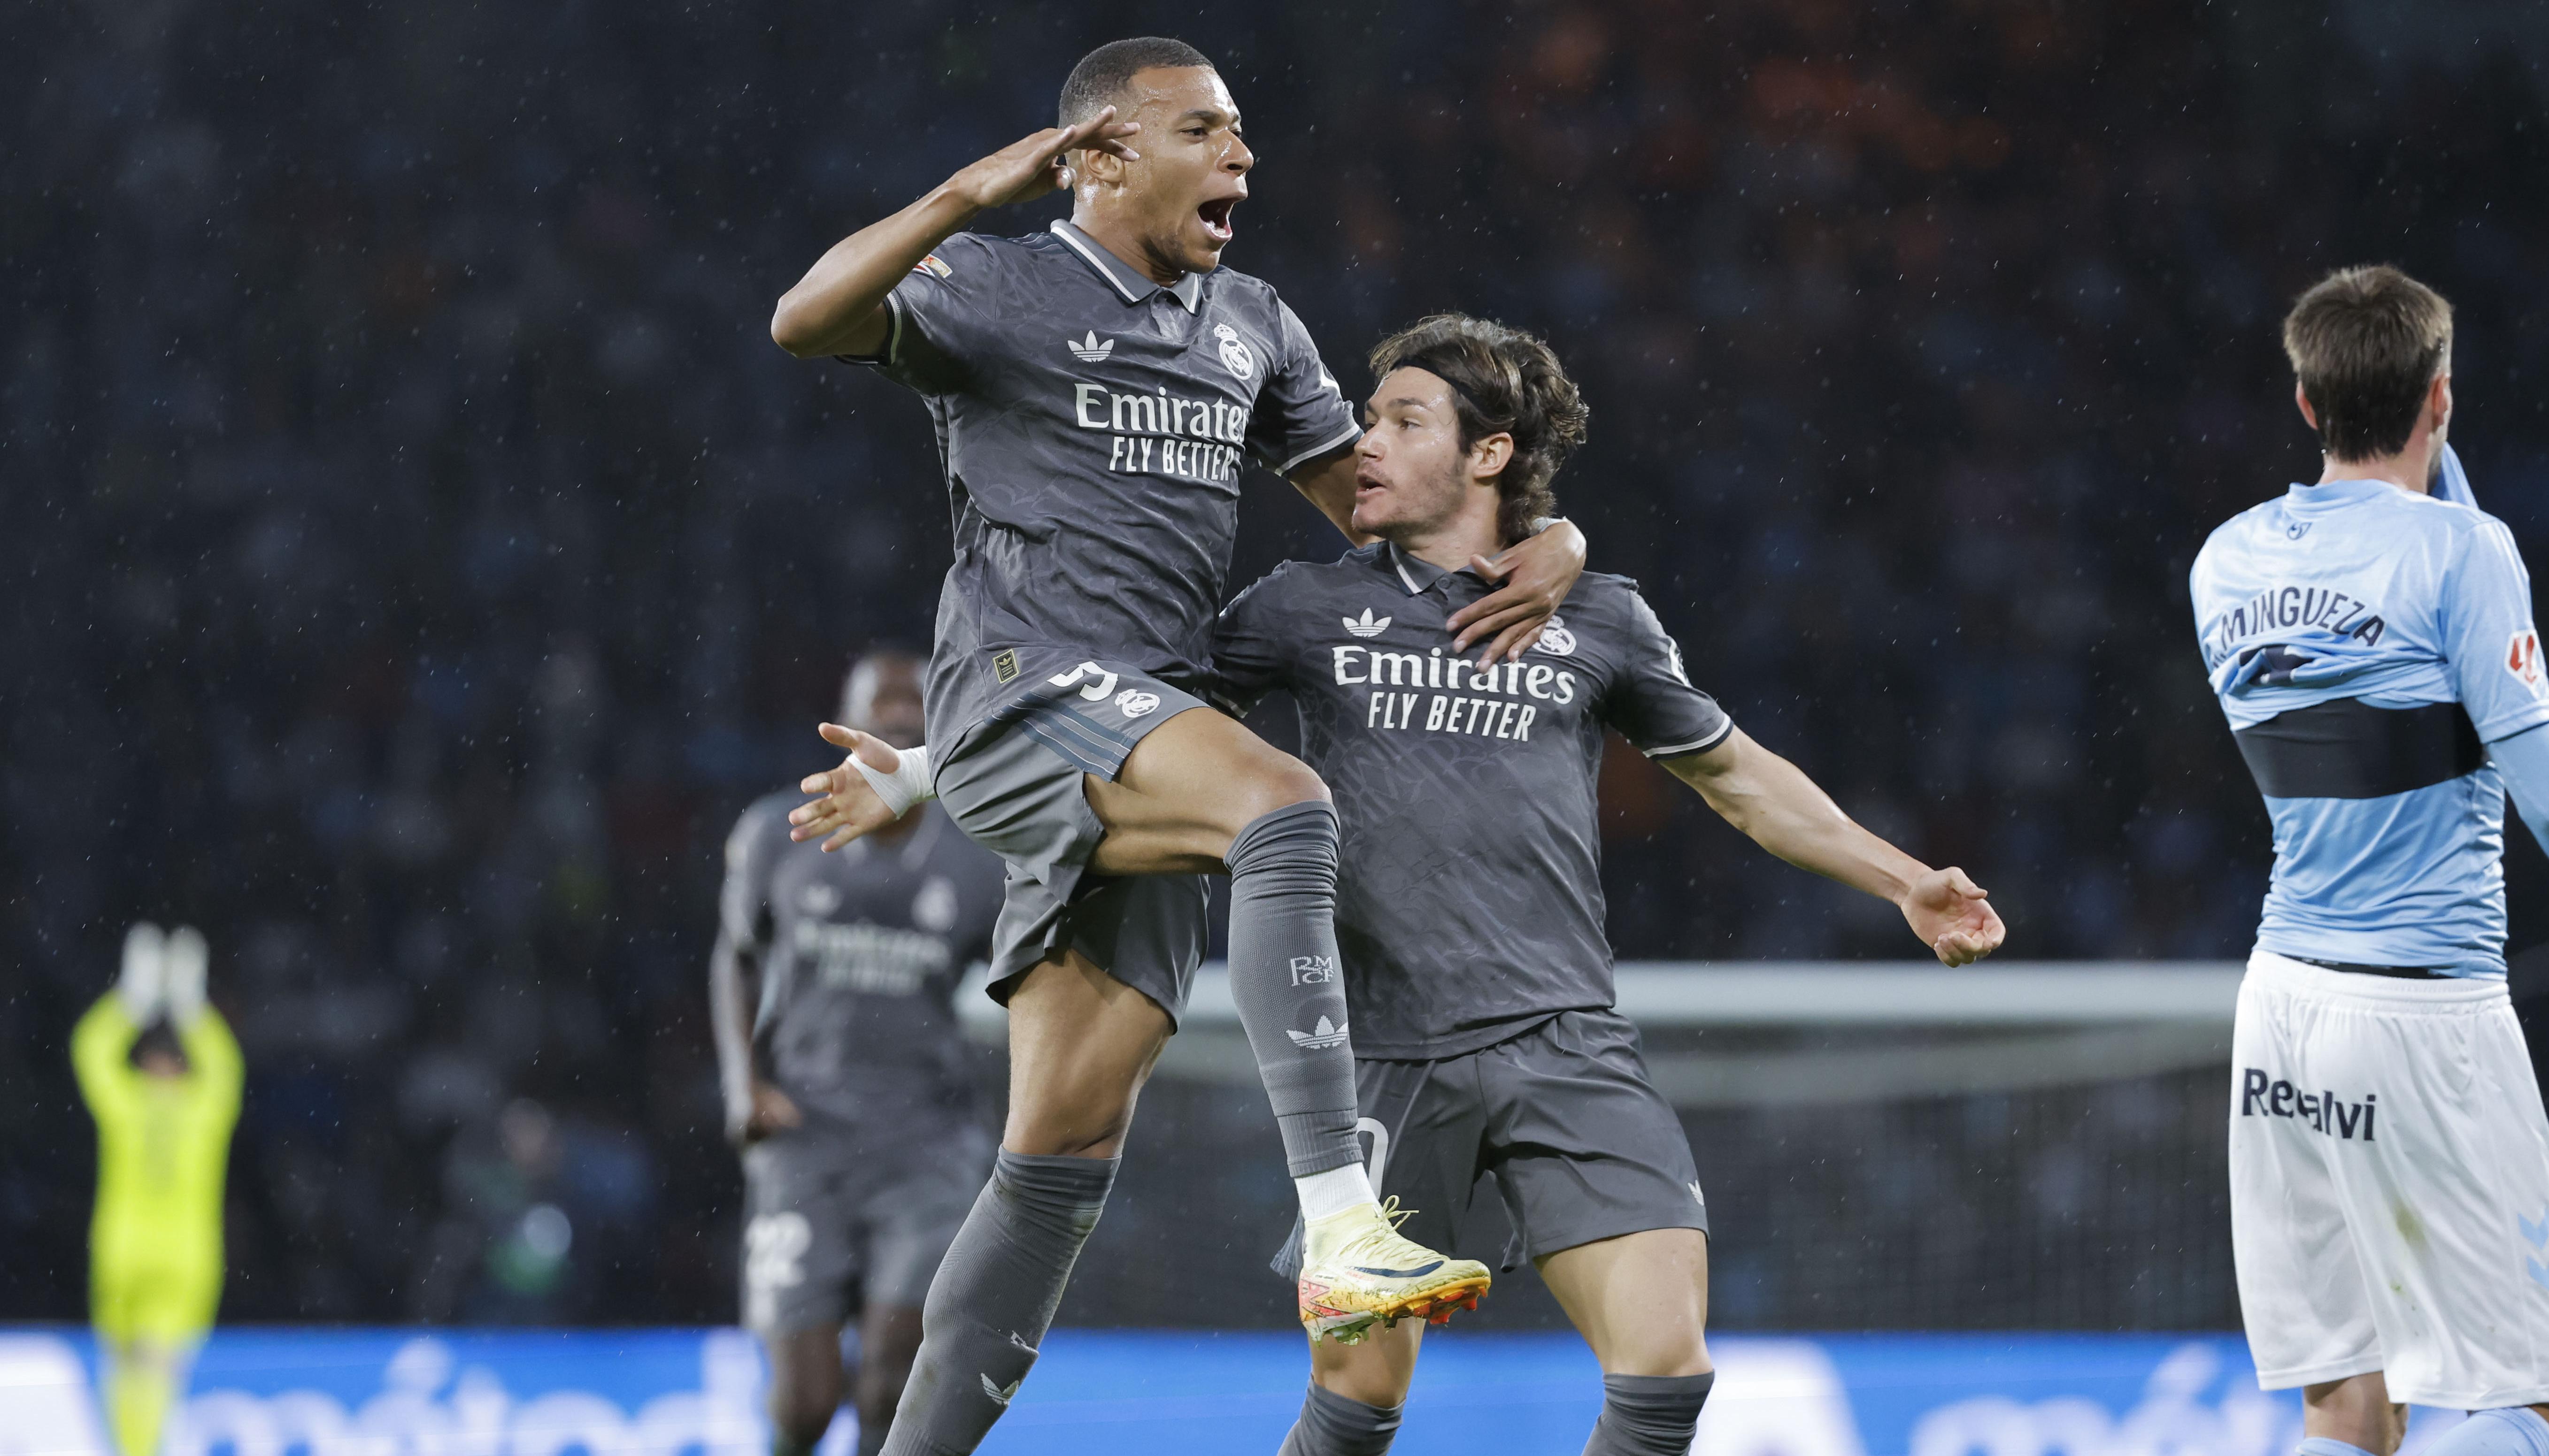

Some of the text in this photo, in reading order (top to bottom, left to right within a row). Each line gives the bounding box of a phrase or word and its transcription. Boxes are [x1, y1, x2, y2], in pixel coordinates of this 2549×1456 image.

[1109, 436, 1234, 481] FLY BETTER
[2221, 587, 2385, 651] MINGUEZA
[1332, 645, 1577, 704] Emirates
[1367, 691, 1537, 742] FLY BETTER
